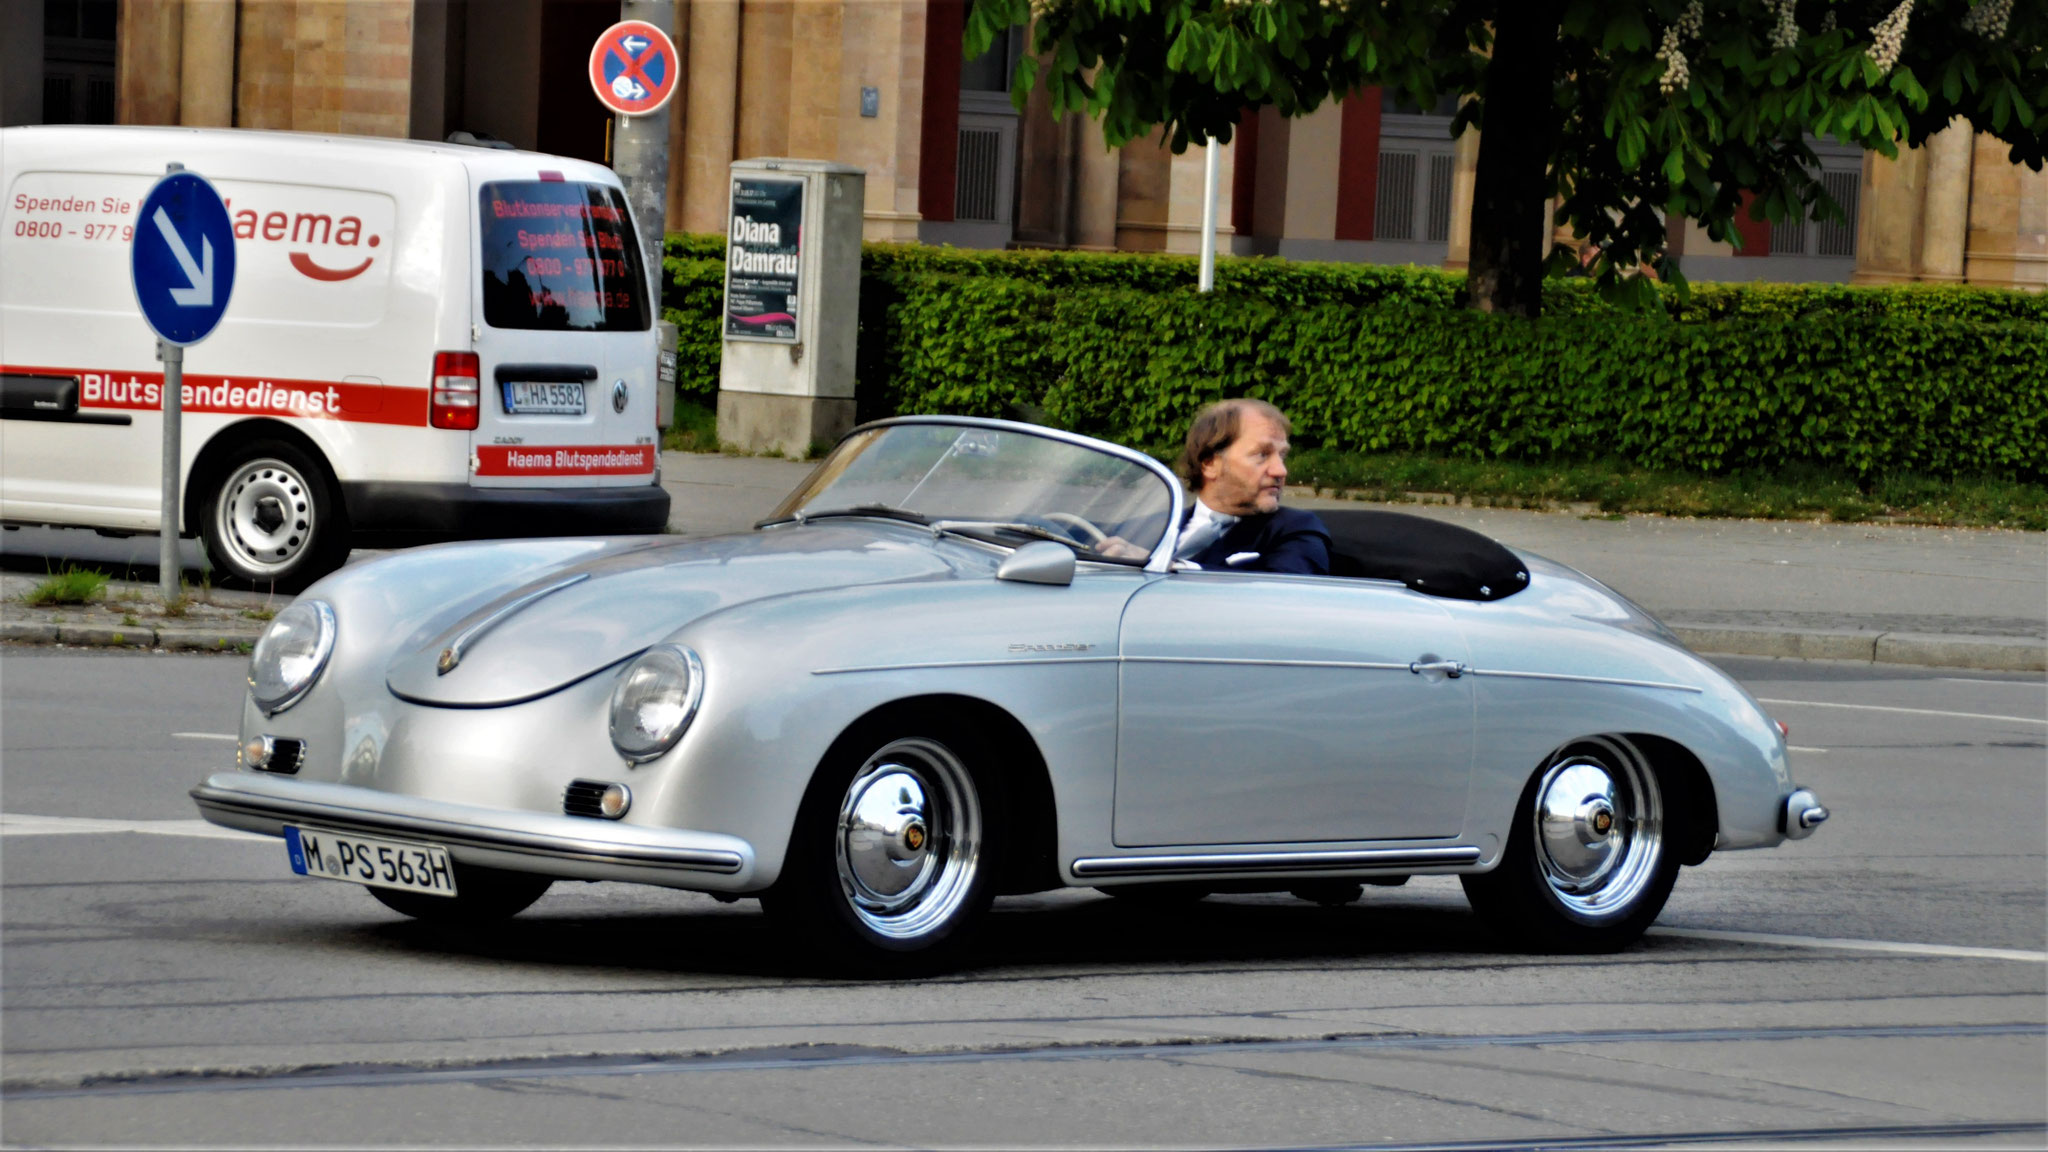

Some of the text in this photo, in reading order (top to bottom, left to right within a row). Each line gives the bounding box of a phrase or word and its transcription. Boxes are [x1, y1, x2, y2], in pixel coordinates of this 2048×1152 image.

[14, 194, 96, 214] Spenden
[101, 197, 130, 214] Sie
[15, 220, 62, 238] 0800
[84, 224, 116, 240] 977
[225, 198, 381, 248] aema.
[733, 215, 780, 244] Diana
[517, 230, 576, 251] Spenden
[526, 257, 561, 276] 0800
[731, 245, 798, 275] Damrau
[83, 374, 340, 412] Blutsendedienst
[512, 384, 582, 406] L HA 5582
[507, 450, 644, 471] Haema Blutspendedienst
[301, 834, 452, 890] M PS 563H
